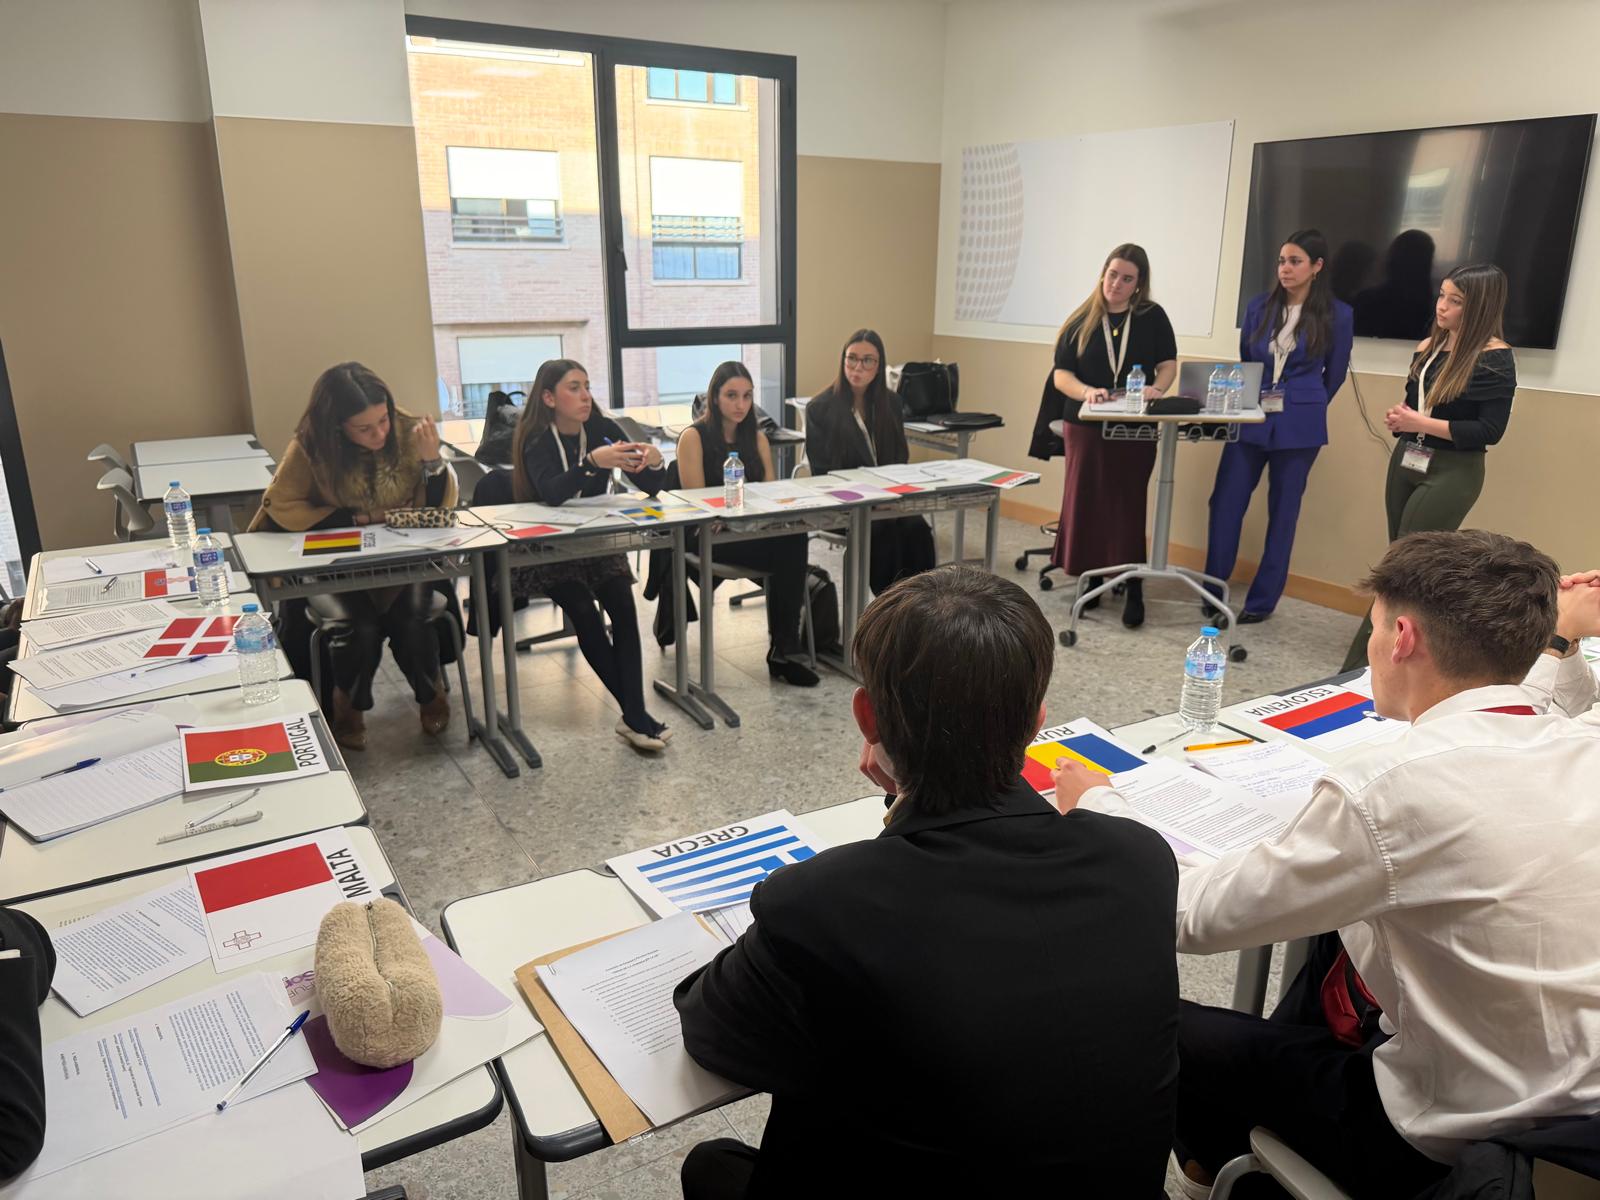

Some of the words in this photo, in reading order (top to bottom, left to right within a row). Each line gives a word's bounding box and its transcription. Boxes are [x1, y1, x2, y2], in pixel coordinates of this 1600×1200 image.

[1244, 683, 1334, 716] ESLOVENIA
[286, 717, 321, 768] PORTUGAL
[651, 825, 749, 858] GRECIA
[326, 848, 372, 899] MALTA
